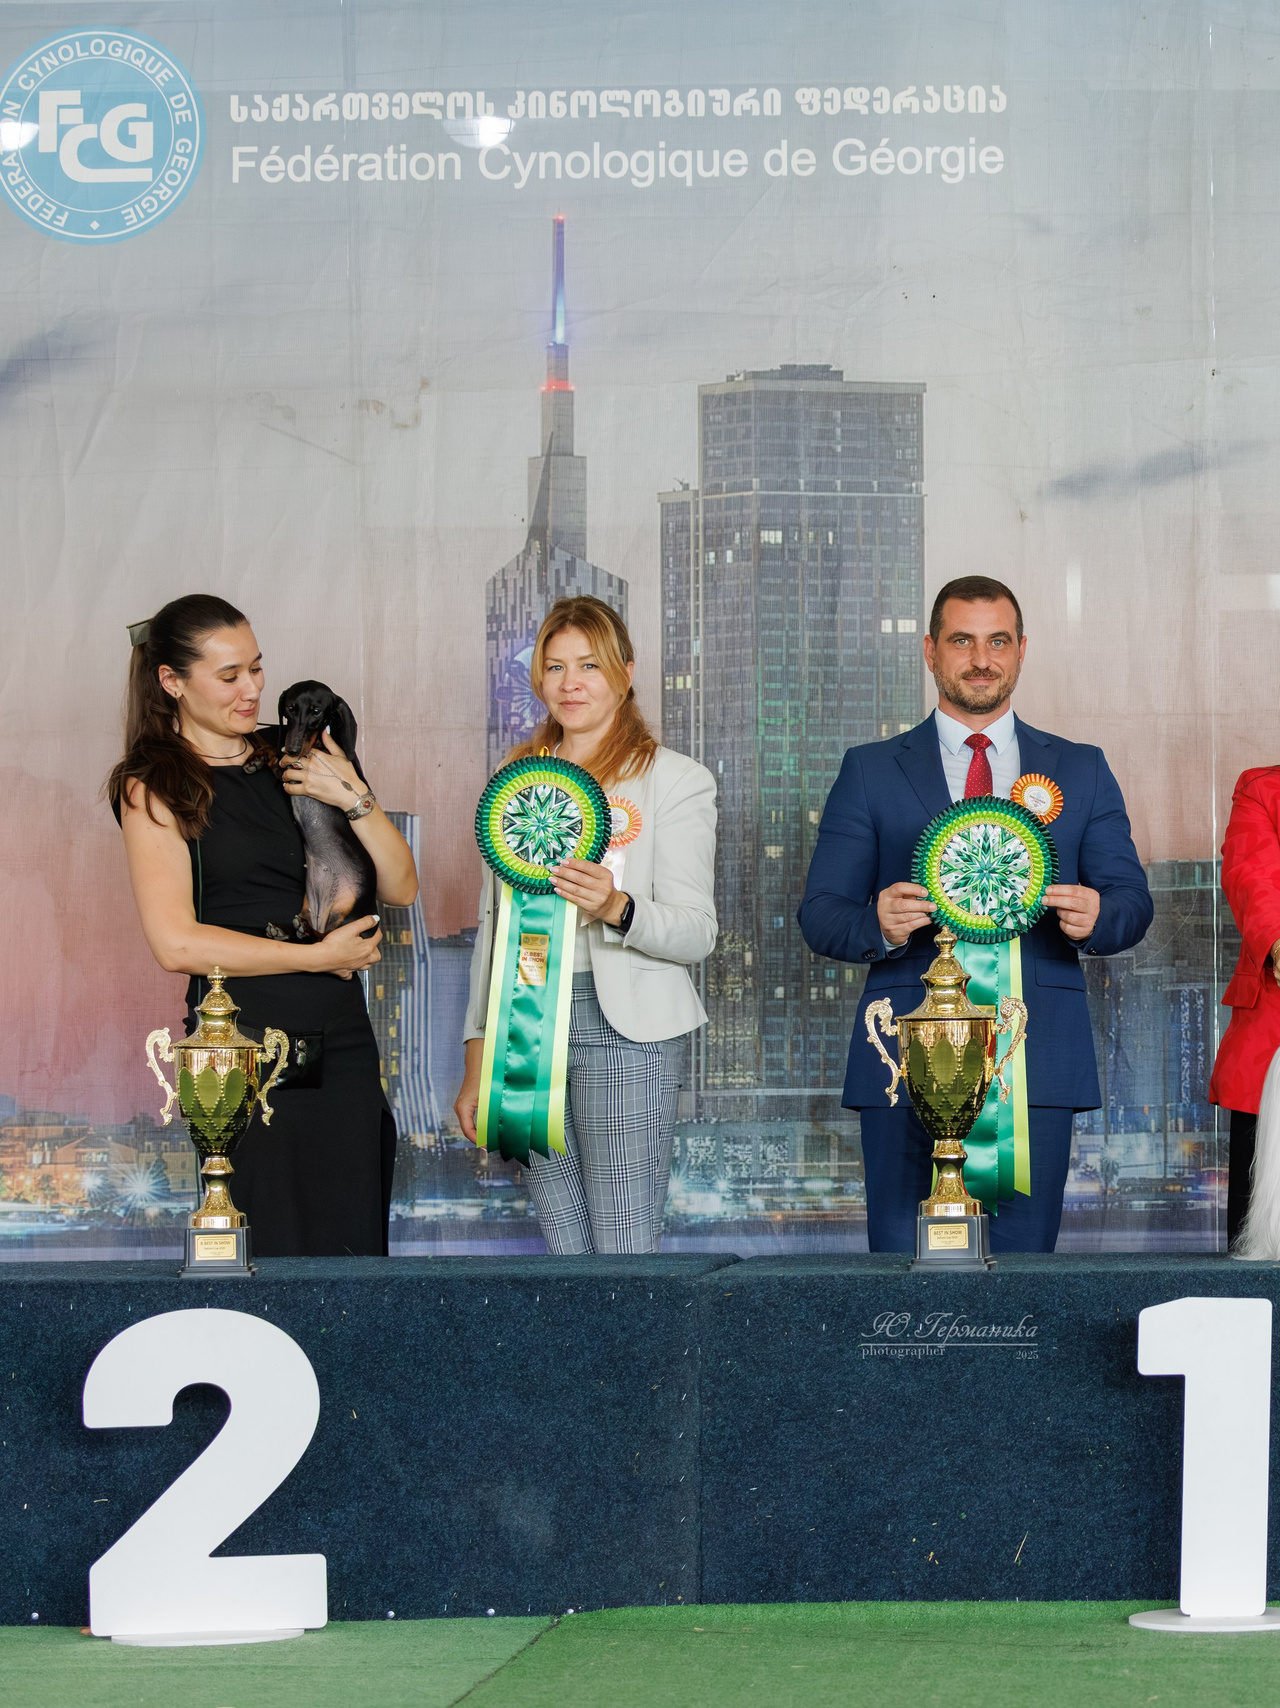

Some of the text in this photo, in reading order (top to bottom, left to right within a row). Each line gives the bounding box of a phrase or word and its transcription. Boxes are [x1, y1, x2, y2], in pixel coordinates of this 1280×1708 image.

[0, 39, 192, 228] FEDERAN CYNOLOGIQUE DE GEORGIE
[38, 89, 154, 183] FCG
[230, 84, 1008, 123] საქართველოს კინოლოგიური ფედერაცია
[231, 137, 1004, 189] Fédération Cynologique de Géorgie
[83, 1308, 328, 1637] 2
[1137, 1297, 1272, 1617] 1
